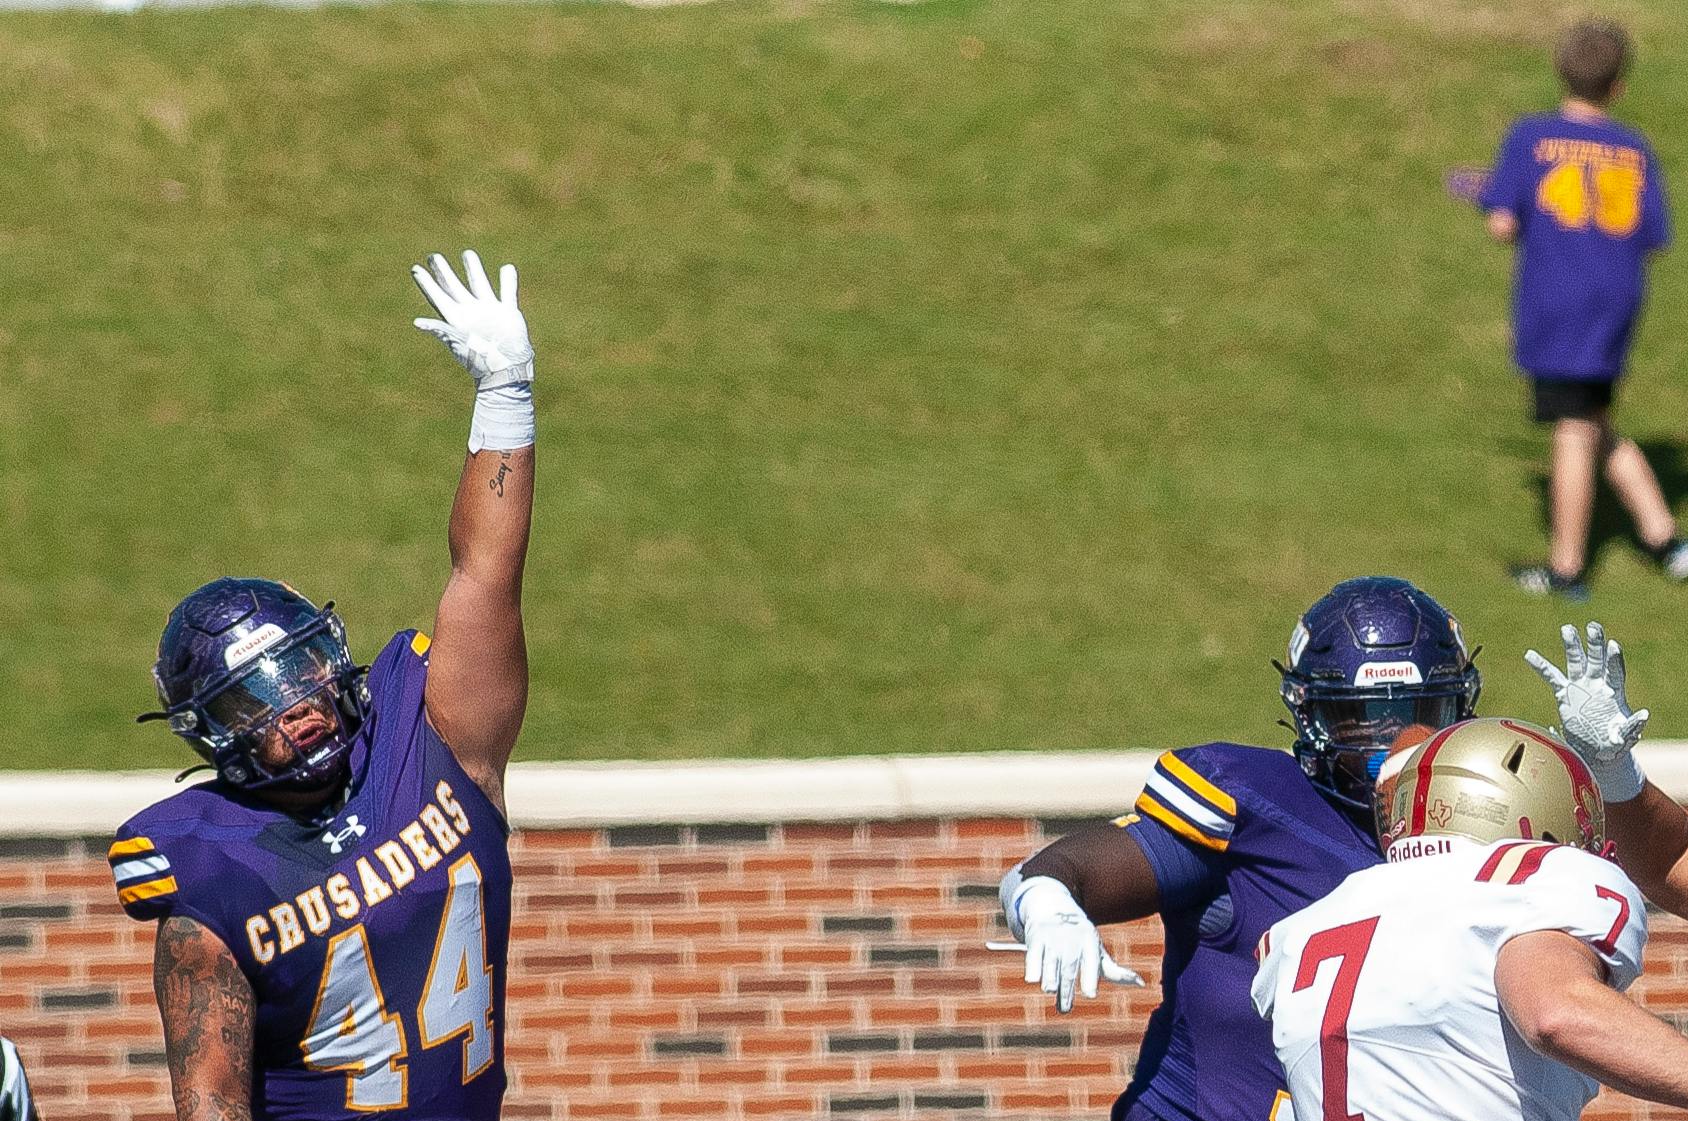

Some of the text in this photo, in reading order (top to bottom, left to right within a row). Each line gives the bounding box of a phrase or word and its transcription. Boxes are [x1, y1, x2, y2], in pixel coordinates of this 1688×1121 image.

[1365, 666, 1413, 678] Riddell
[246, 779, 471, 965] CRUSADERS
[1390, 840, 1451, 863] Riddell
[1590, 884, 1630, 958] 7
[300, 852, 495, 1112] 44
